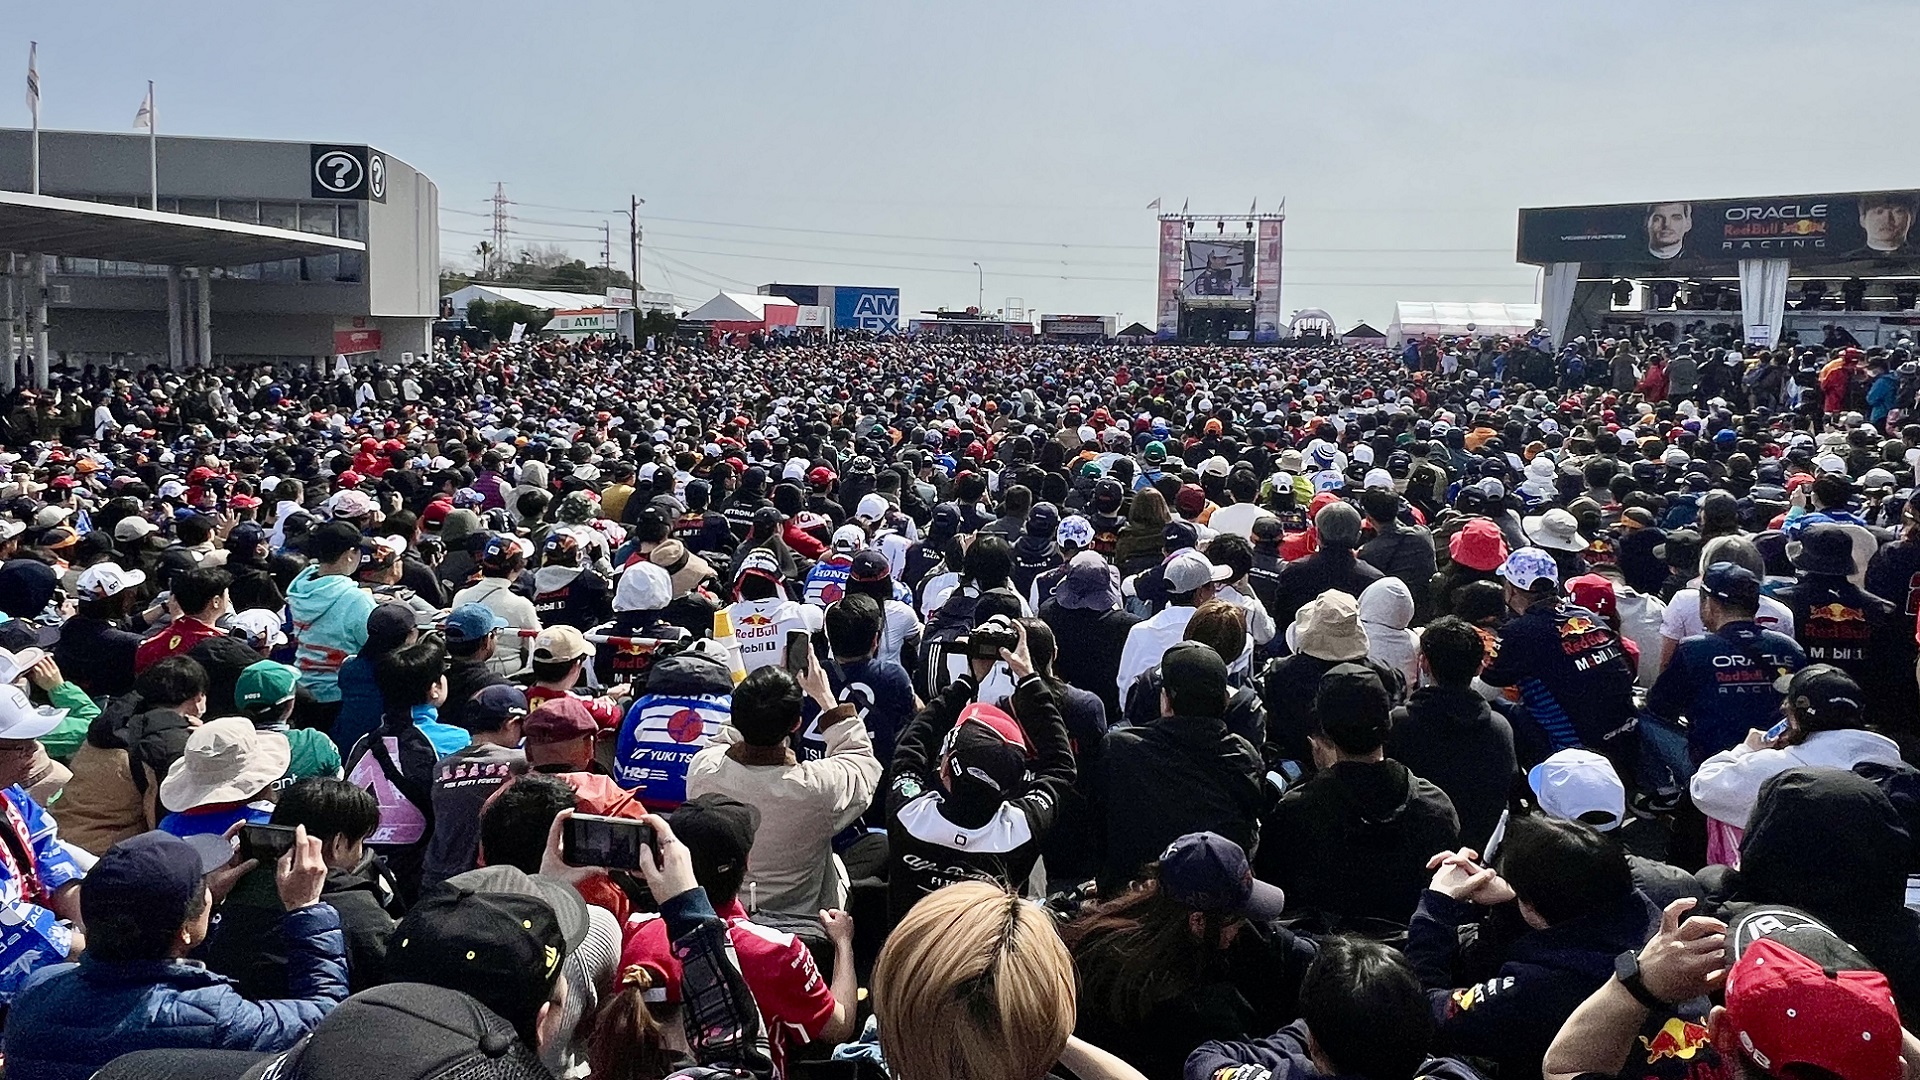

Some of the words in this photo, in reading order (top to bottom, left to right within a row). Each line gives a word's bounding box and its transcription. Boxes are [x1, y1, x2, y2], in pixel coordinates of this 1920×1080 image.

[1725, 204, 1828, 220] ORACLE
[1722, 239, 1826, 250] RACING
[854, 294, 898, 317] AM
[574, 317, 599, 327] ATM
[814, 569, 850, 579] HOND
[735, 628, 755, 639] Red
[756, 624, 778, 637] Bull
[1718, 685, 1772, 694] RACI
[650, 750, 677, 762] YUKI
[679, 752, 694, 764] TS
[270, 773, 298, 791] ant
